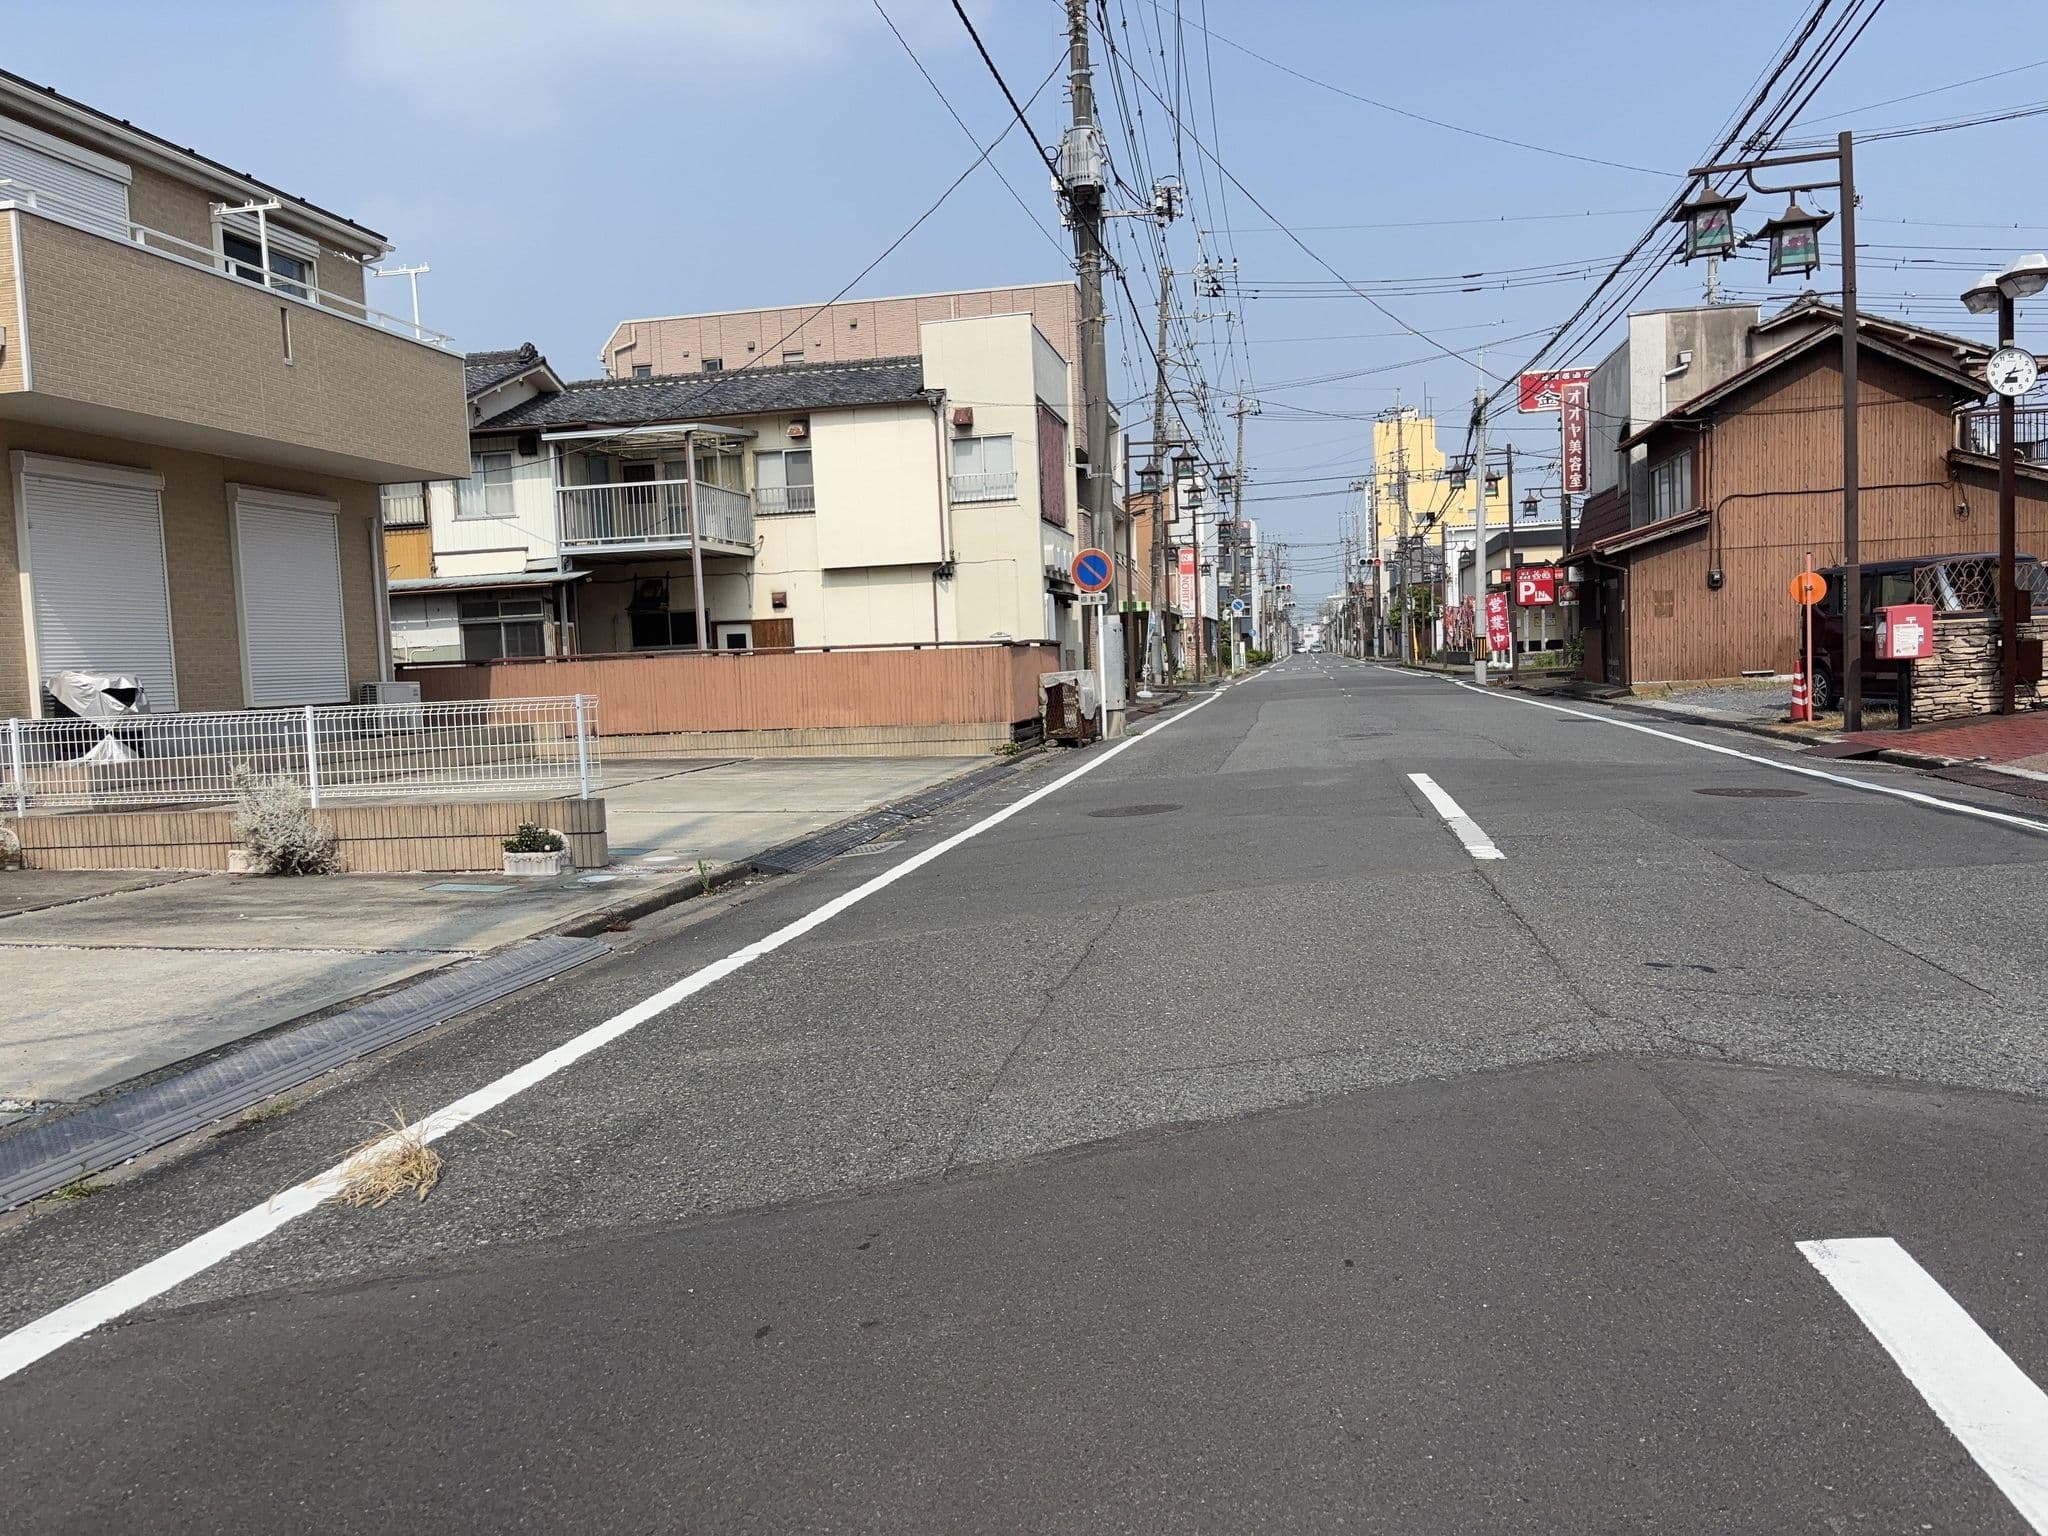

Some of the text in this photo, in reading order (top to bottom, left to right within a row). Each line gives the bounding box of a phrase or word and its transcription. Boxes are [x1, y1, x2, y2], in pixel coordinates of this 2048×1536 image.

[1567, 389, 1583, 488] オオヤ美容室
[1182, 575, 1190, 610] NORITZ
[1520, 581, 1546, 602] P IN
[1488, 597, 1507, 648] 営業中
